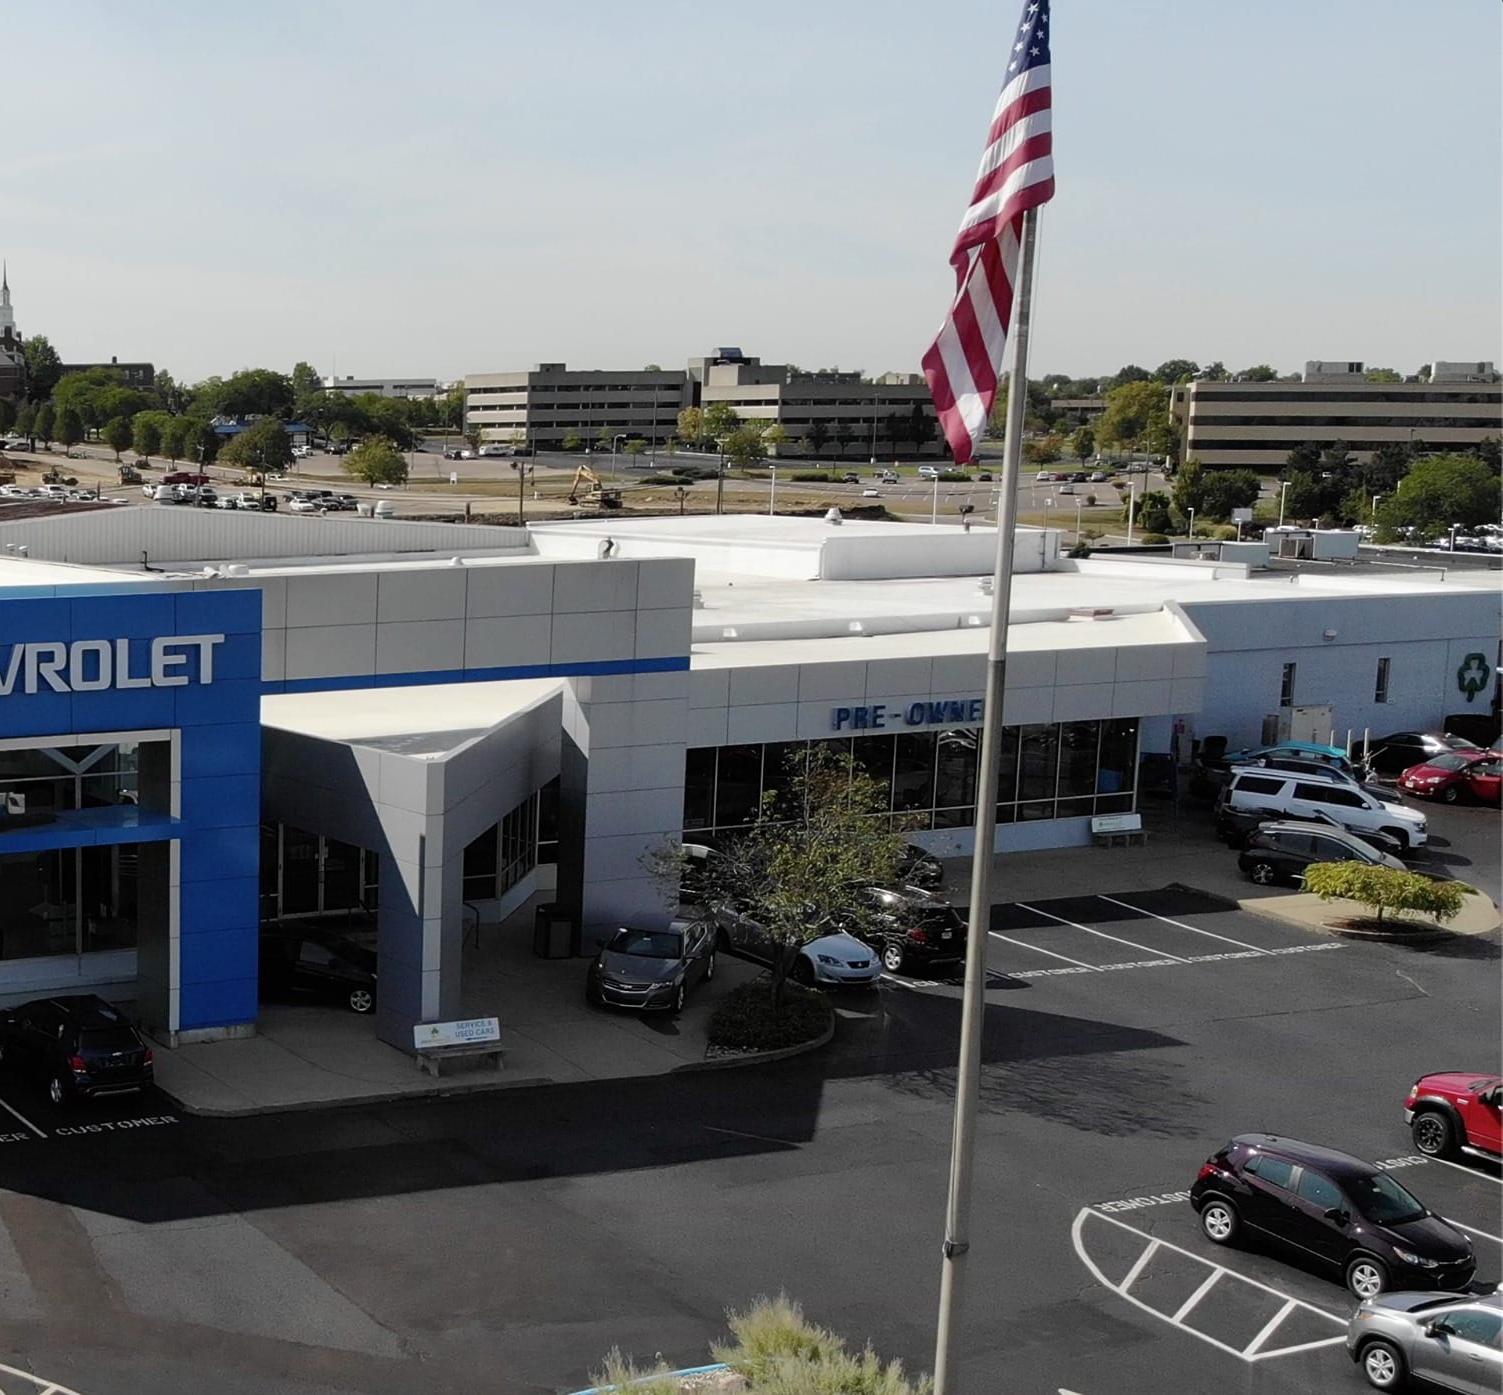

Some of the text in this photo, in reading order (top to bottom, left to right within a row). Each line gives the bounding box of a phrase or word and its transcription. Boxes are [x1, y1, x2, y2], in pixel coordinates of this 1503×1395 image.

[833, 698, 986, 731] PRE-OWNE
[455, 1027, 495, 1038] USED CARS
[456, 1020, 484, 1030] SERVICE
[55, 1115, 180, 1136] CUSTOMER
[1093, 1189, 1192, 1212] USTOMER
